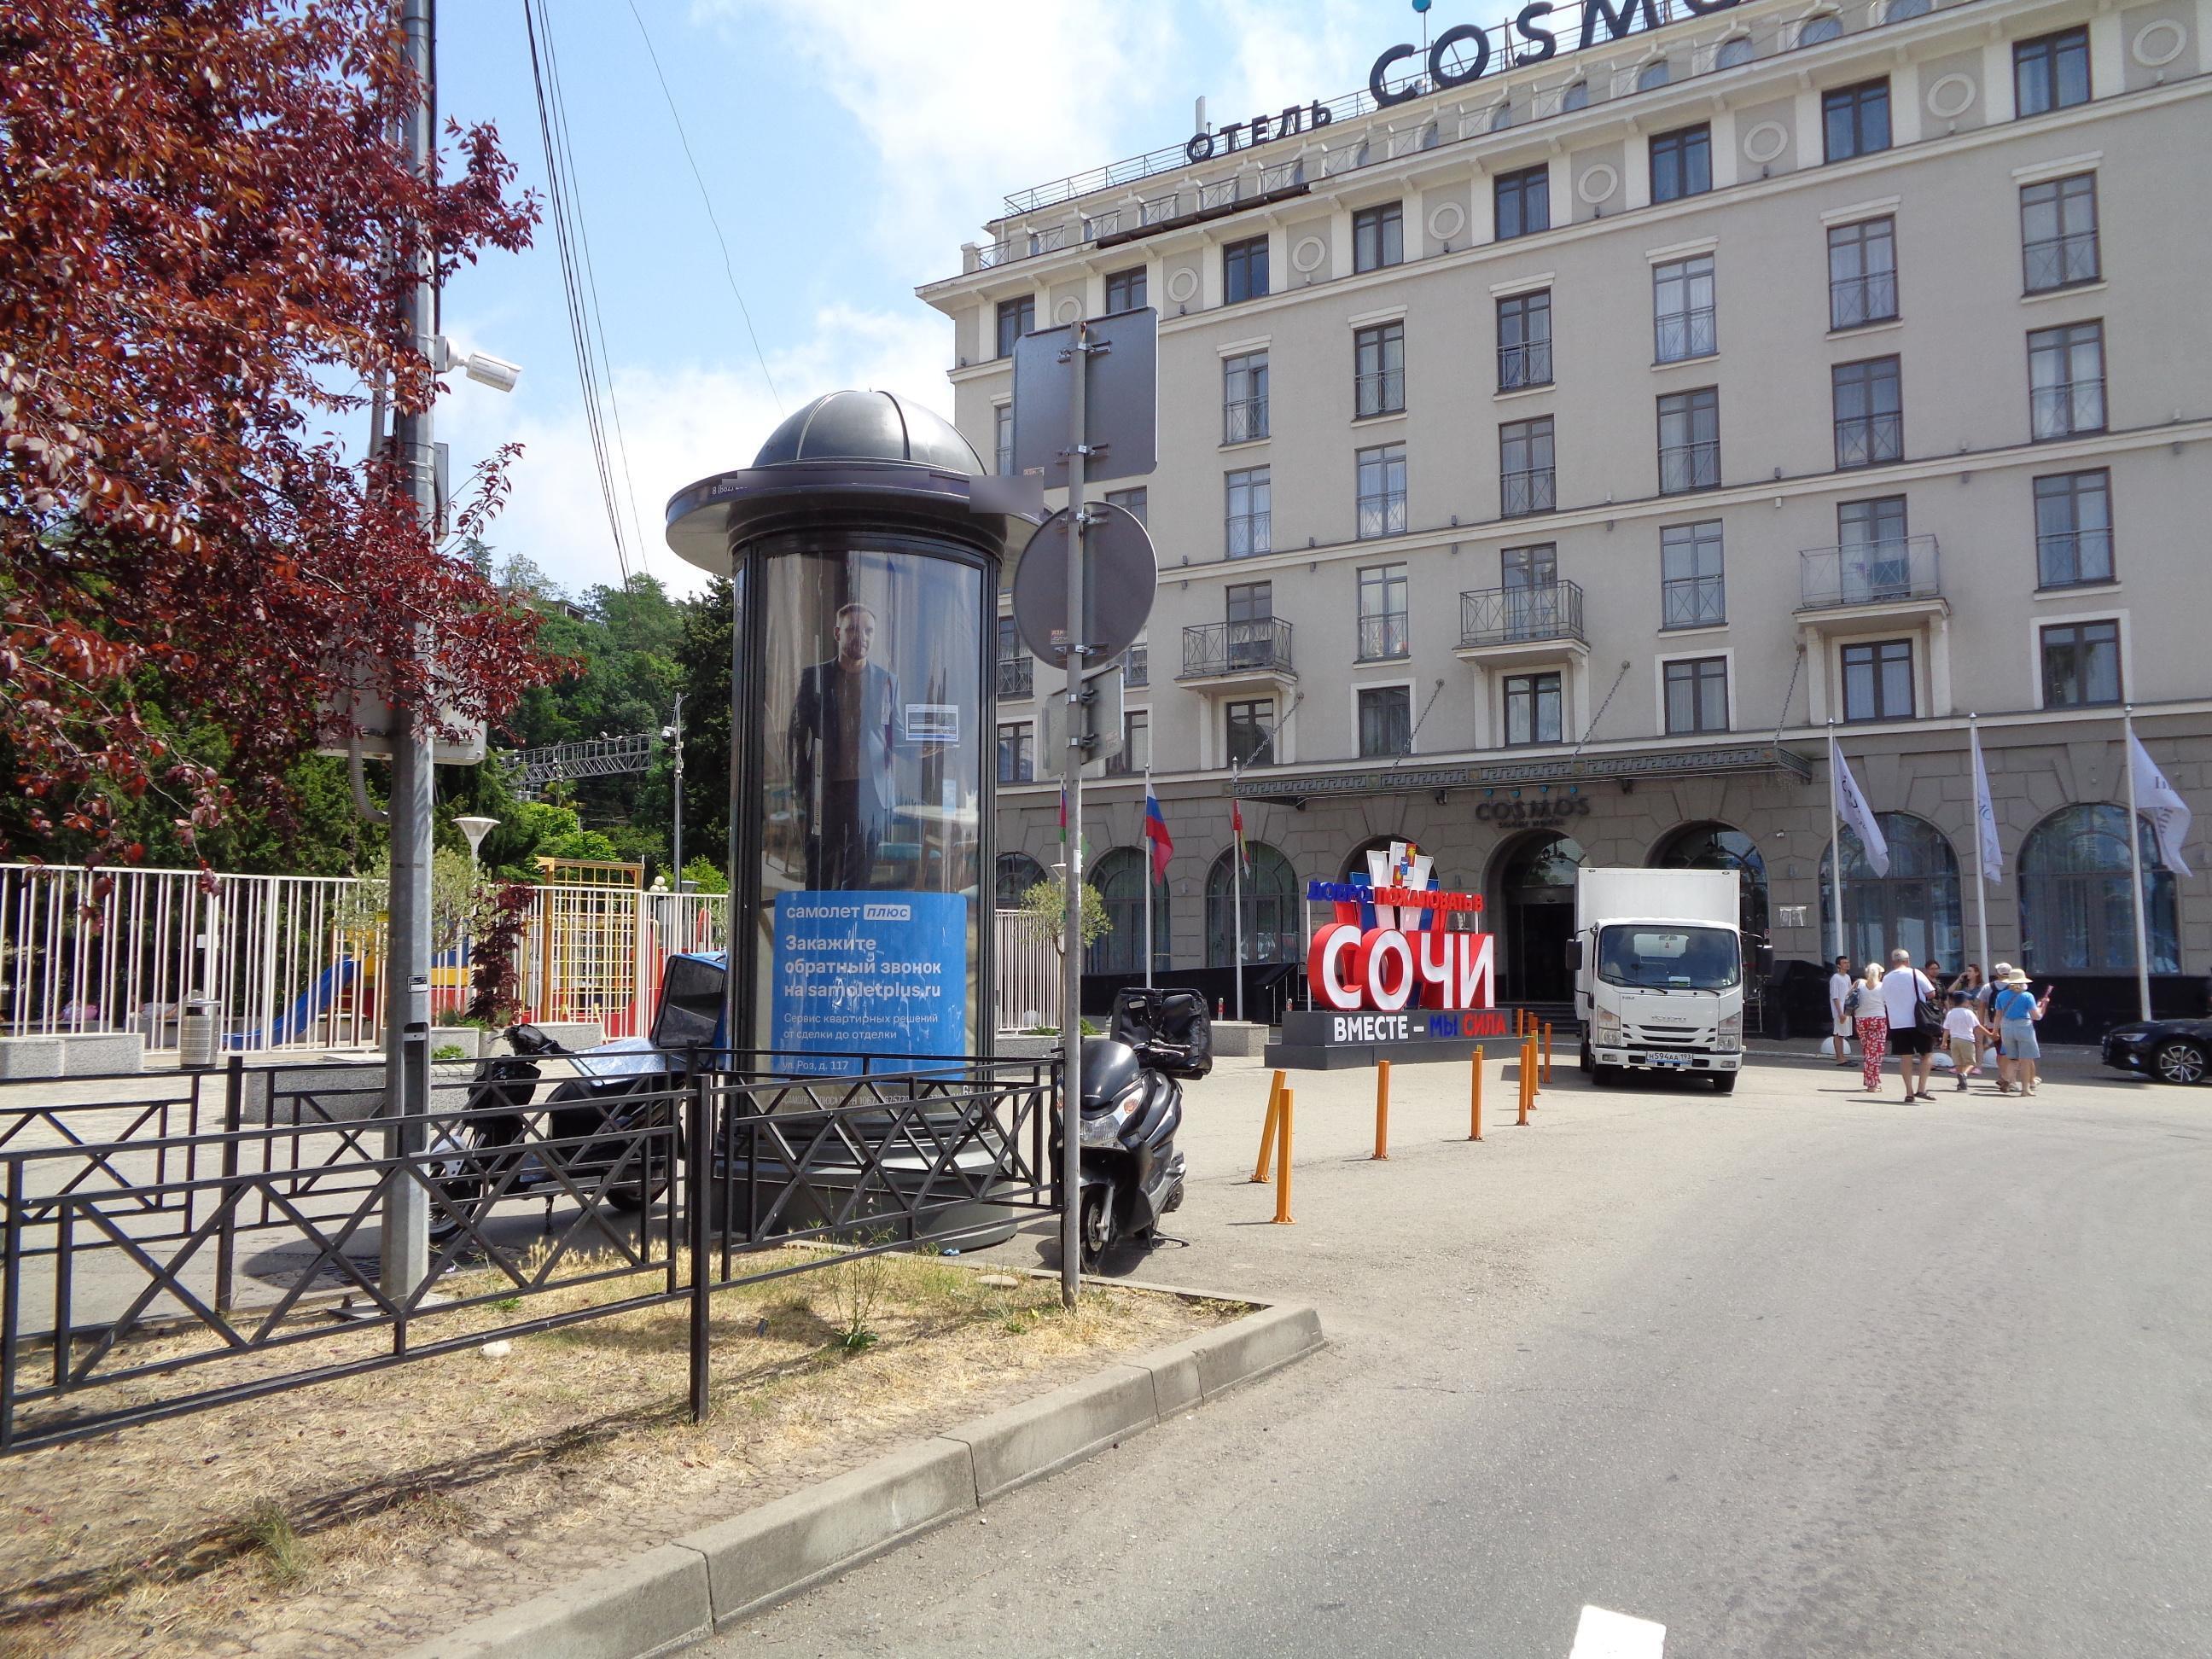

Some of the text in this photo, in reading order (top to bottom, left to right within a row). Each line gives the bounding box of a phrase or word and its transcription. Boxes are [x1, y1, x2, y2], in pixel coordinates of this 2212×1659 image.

[1186, 99, 1333, 164] ОТЕЛЬ
[1475, 796, 1591, 821] COSMOS
[1307, 881, 1484, 911] ДОБРО ПОЖАЛОВАТЬ В
[786, 905, 860, 918] самолет
[785, 934, 876, 951] Закажите
[784, 956, 941, 977] обратный звонок
[1309, 923, 1495, 1010] СОЧИ
[784, 982, 940, 1000] на samoletplus.ru
[784, 1012, 938, 1025] Сервис квартирных решений
[1334, 1016, 1408, 1042] ВМЕСТЕ
[1429, 1015, 1458, 1038] МЫ
[1462, 1012, 1507, 1037] СИЛА
[796, 1030, 833, 1039] сделки
[835, 1031, 849, 1040] до
[852, 1031, 897, 1040] отделки
[783, 1060, 848, 1072] ул. Роз, д. 117
[963, 1086, 974, 1096] 6+
